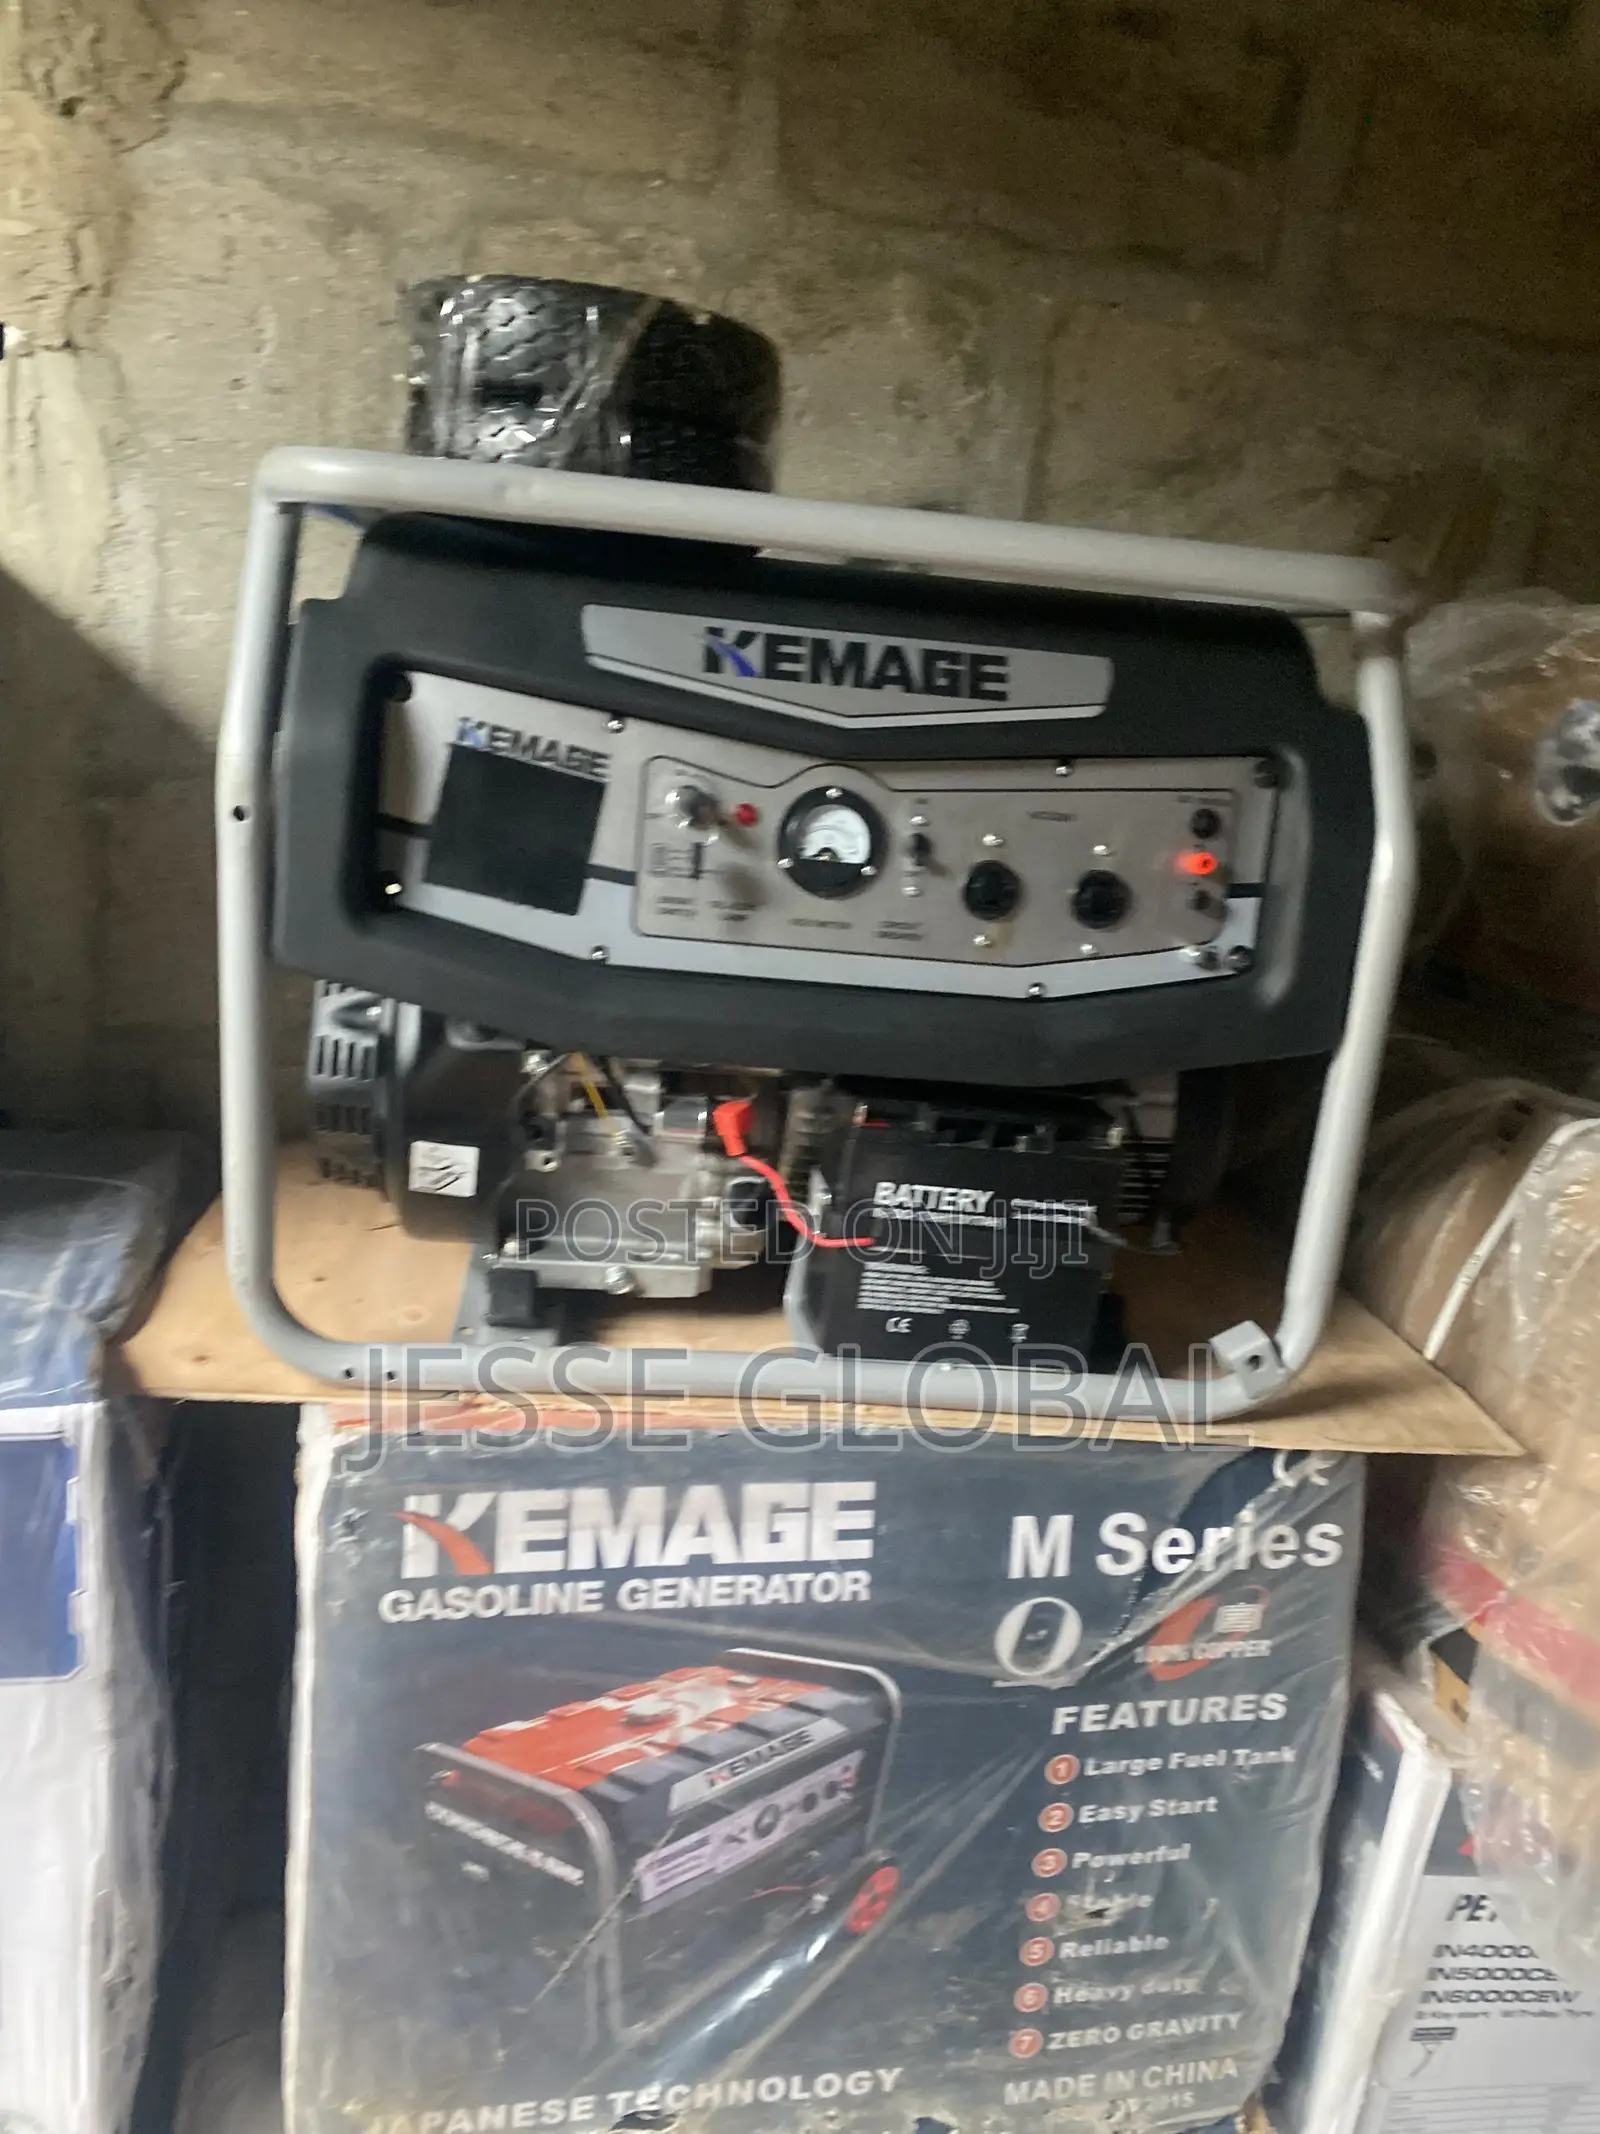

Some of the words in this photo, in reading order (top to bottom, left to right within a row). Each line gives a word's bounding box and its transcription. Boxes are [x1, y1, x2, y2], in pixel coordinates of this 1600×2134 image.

[700, 626, 1008, 702] KEMAGE
[456, 716, 611, 783] KEMAGE
[873, 1181, 994, 1213] BATTERY
[395, 1481, 877, 1578] KEMAGE
[1007, 1514, 1074, 1579] M
[1095, 1503, 1345, 1576] Series
[378, 1580, 603, 1624] GASOLINE
[617, 1570, 872, 1612] GENERATOR
[1051, 1692, 1289, 1735] FEATURES
[1084, 1755, 1163, 1777] Large
[1168, 1750, 1227, 1769] Fuel
[1232, 1746, 1297, 1767] Tank
[1078, 1803, 1140, 1826] Easy
[1147, 1796, 1219, 1817] Start
[1072, 1844, 1191, 1869] Powerful
[1445, 1894, 1497, 1922] PE
[1058, 1934, 1171, 1959] Reliable
[1432, 1944, 1540, 1959] IN4000
[1053, 1983, 1135, 2004] Heavy
[1047, 2026, 1122, 2050] ZERO
[1126, 2012, 1243, 2041] GRAVITY
[605, 2066, 904, 2119] TECHNOLOGY
[1004, 2073, 1098, 2106] MADE
[1104, 2068, 1136, 2092] IN
[1142, 2057, 1239, 2088] CHINA
